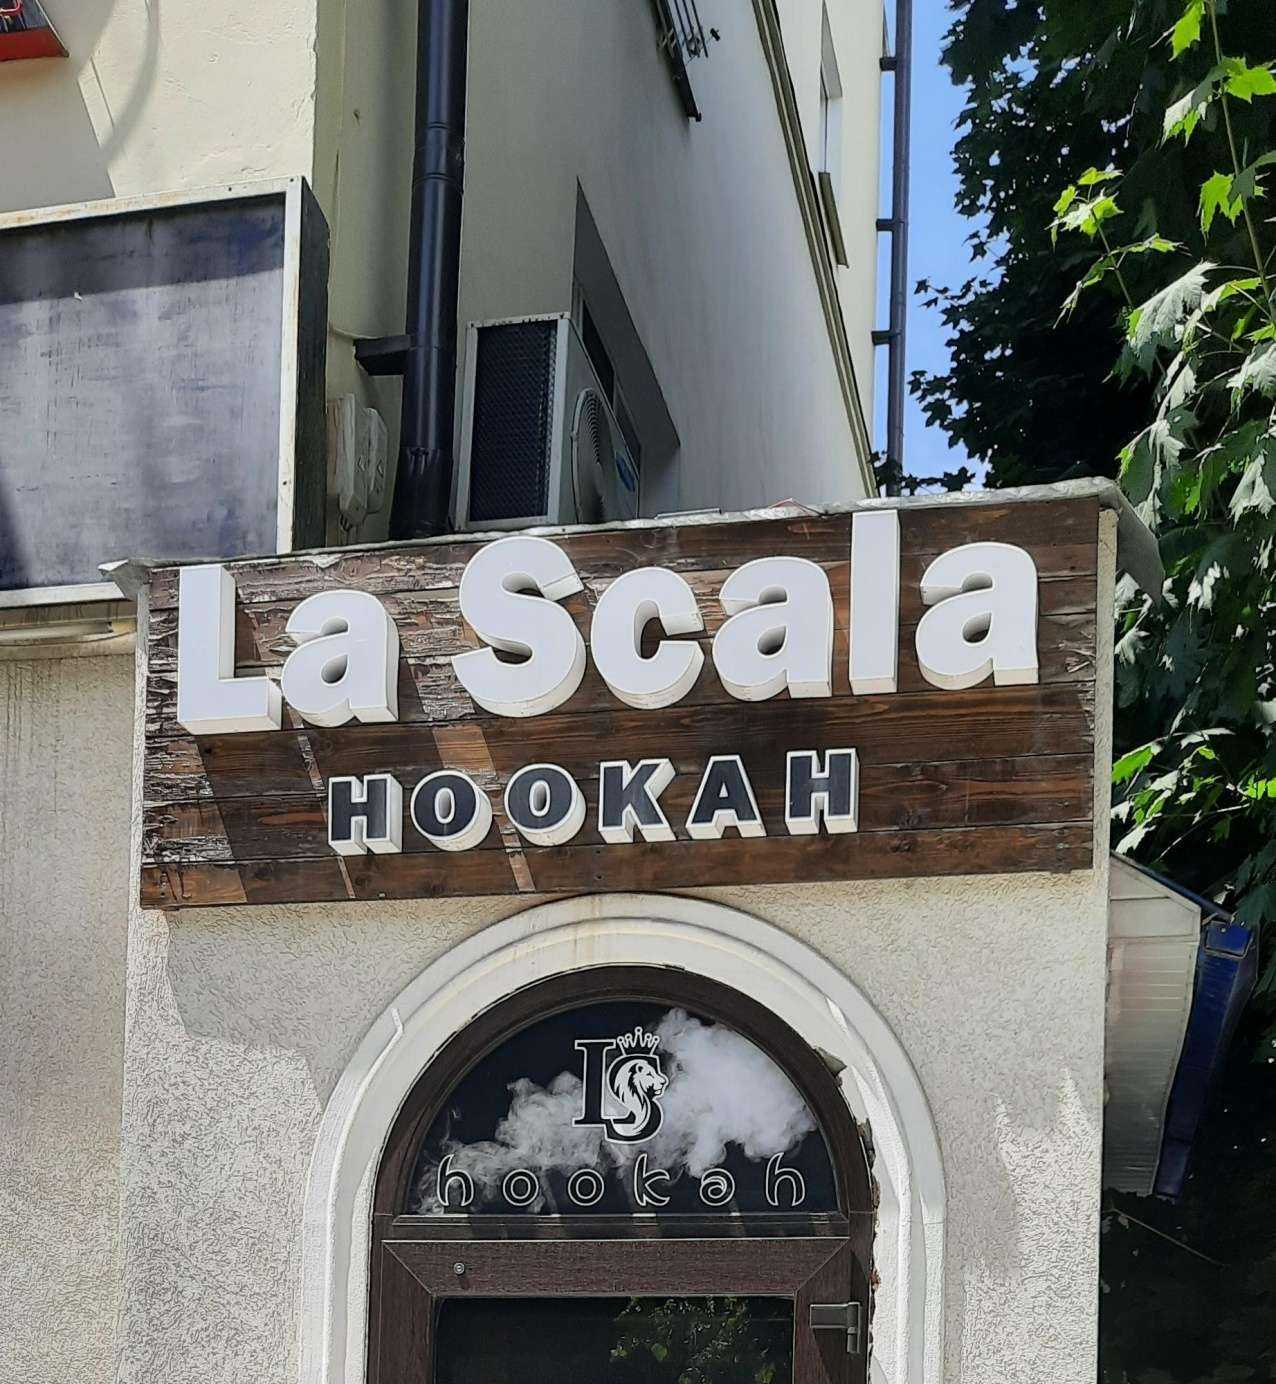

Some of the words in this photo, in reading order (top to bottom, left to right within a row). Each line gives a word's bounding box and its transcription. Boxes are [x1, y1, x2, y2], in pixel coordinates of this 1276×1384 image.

[176, 563, 400, 736] La
[451, 509, 1040, 718] Scala
[327, 748, 860, 856] HOOKAH
[436, 1152, 806, 1207] hookah
